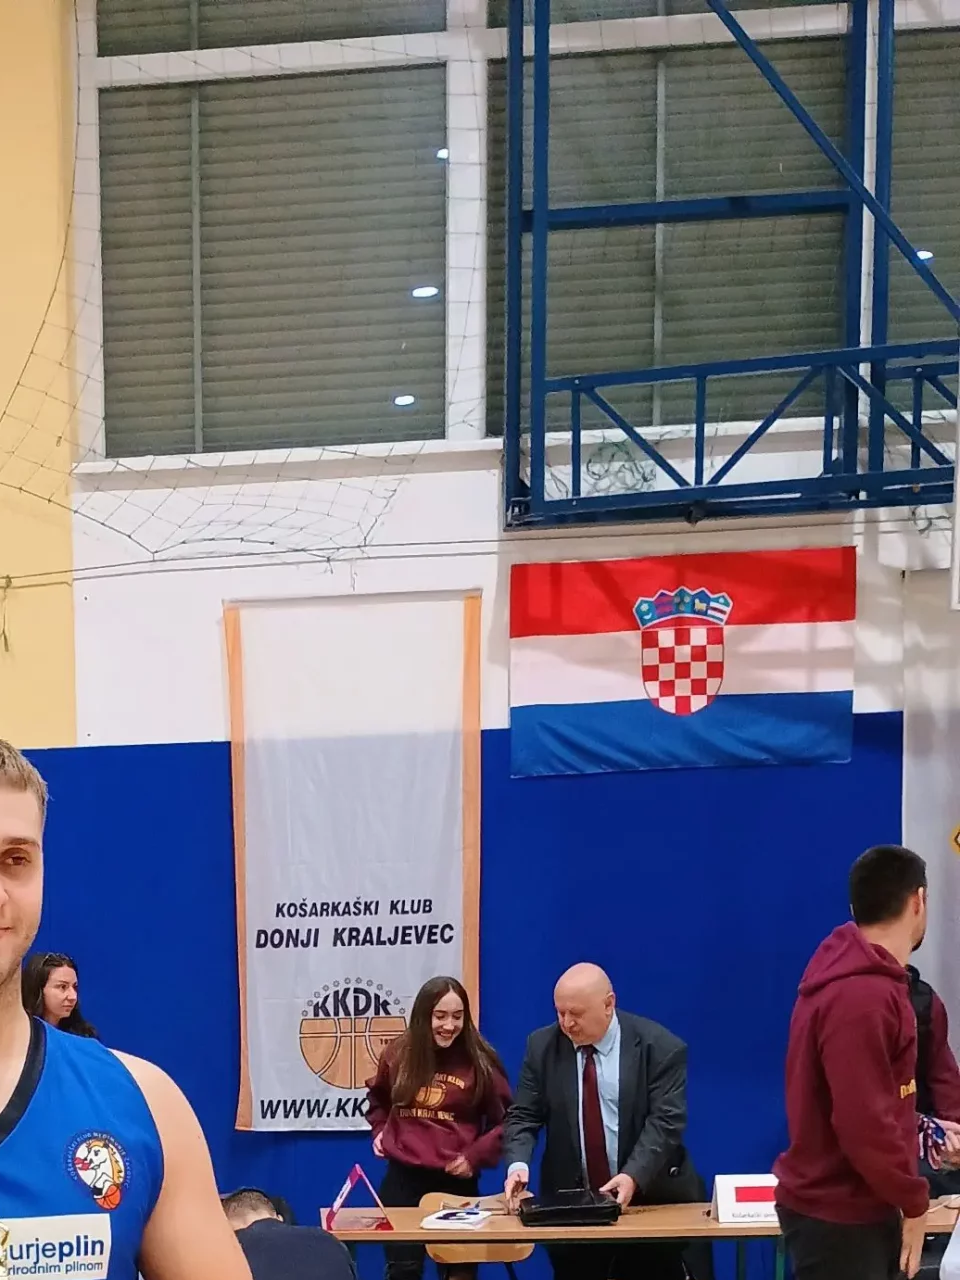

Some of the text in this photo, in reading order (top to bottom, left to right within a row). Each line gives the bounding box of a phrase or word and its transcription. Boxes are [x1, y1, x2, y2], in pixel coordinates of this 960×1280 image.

[275, 896, 433, 918] KOŠARKAŠKI KLUB
[255, 923, 454, 949] DONJI KRALJEVEC
[260, 1098, 369, 1119] WWW.KK
[7, 1262, 61, 1276] rirodnim
[65, 1260, 103, 1273] plinom
